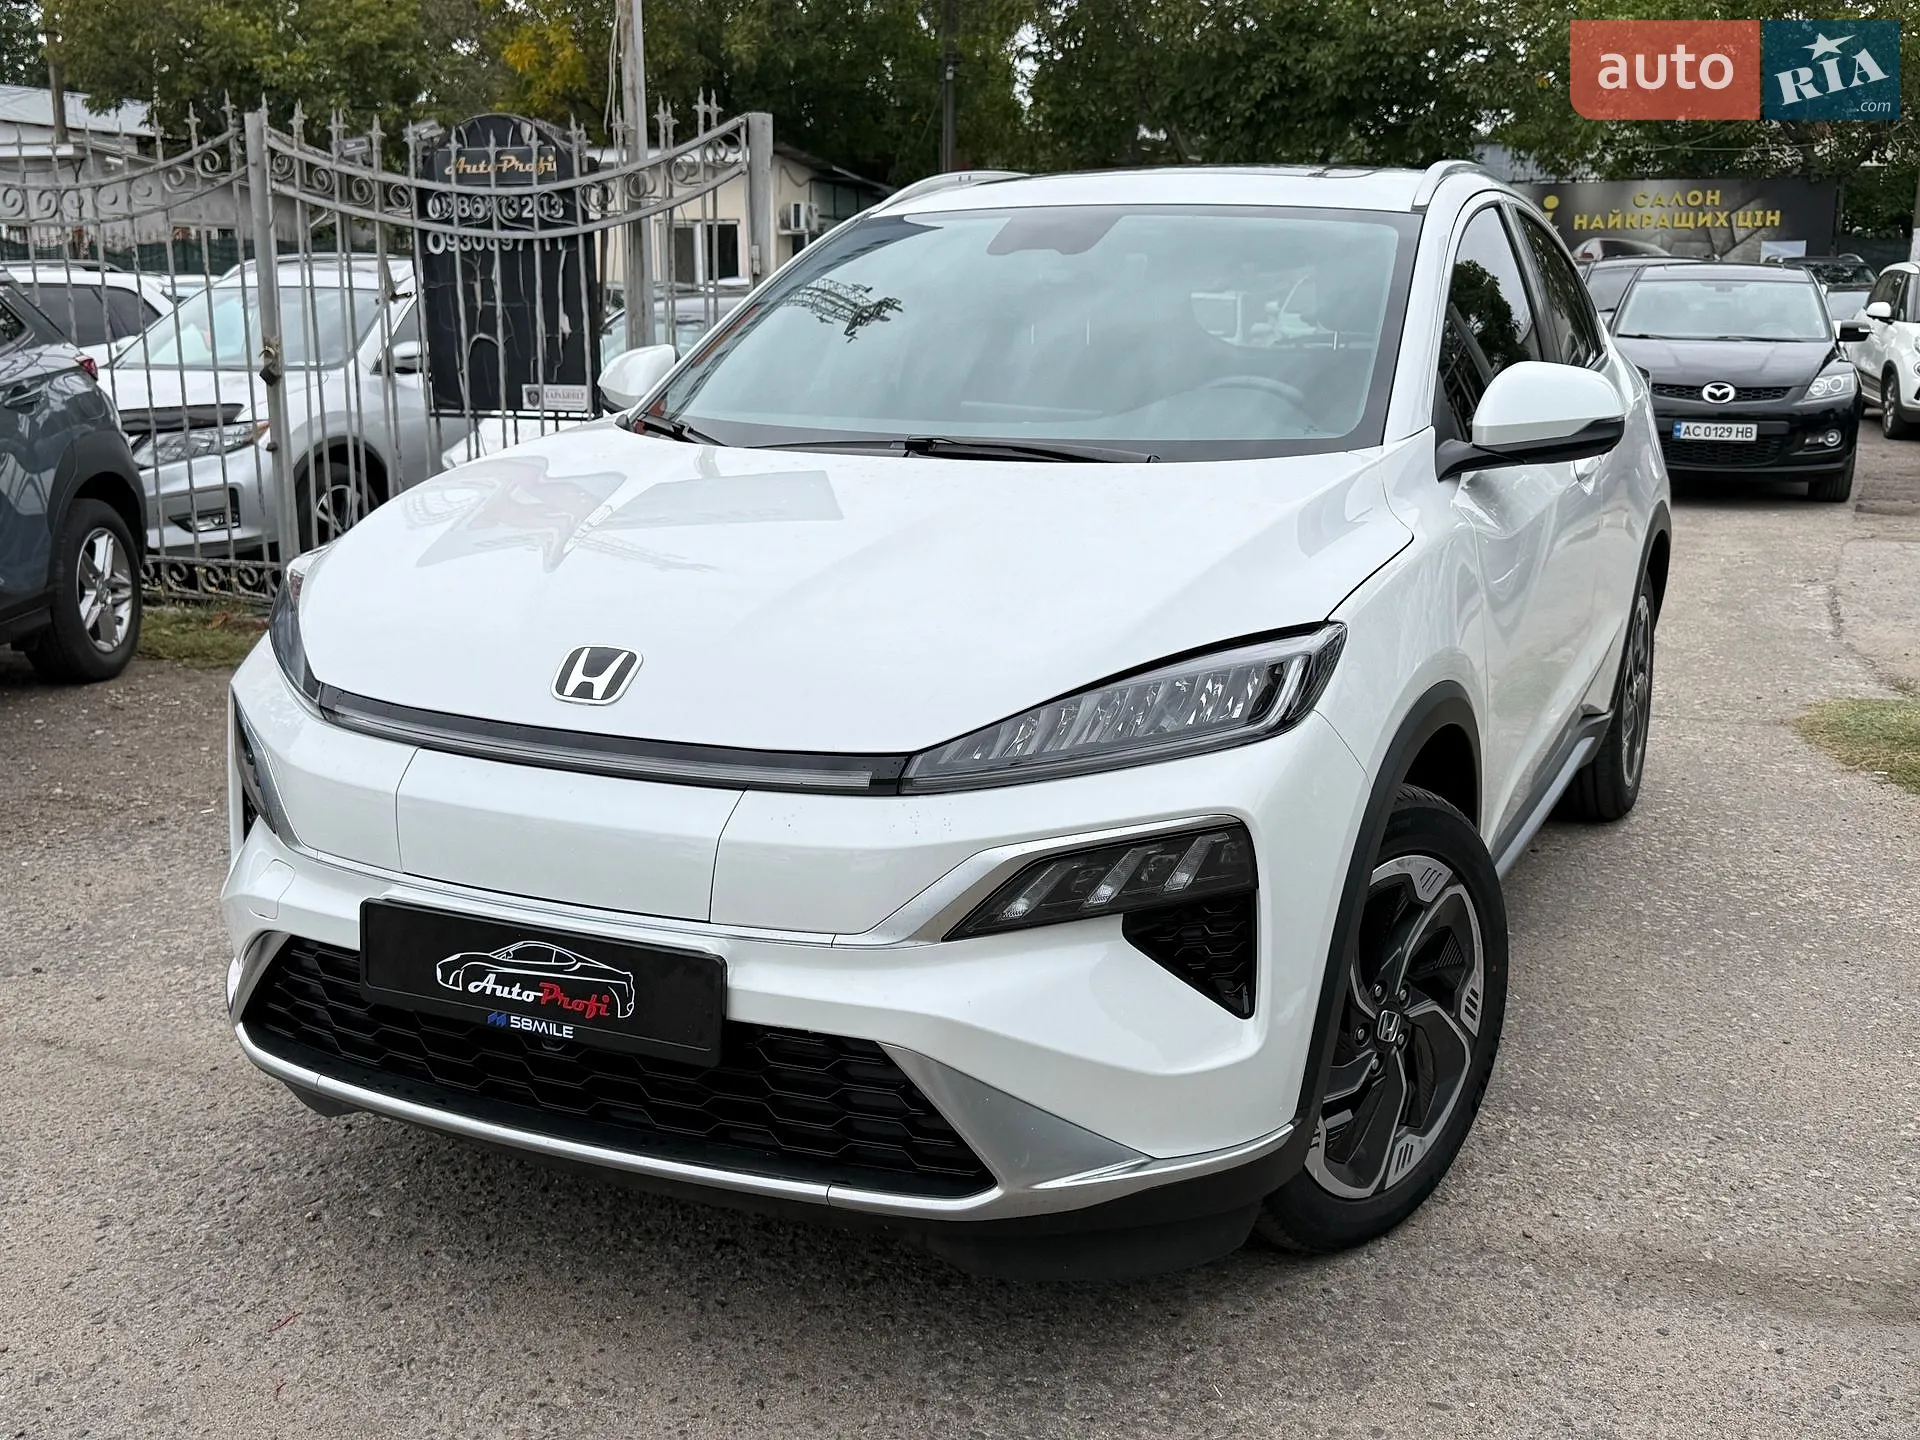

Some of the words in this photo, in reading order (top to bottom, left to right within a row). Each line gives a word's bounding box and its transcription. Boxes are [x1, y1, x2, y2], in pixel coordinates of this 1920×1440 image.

[1633, 189, 1721, 208] САЛОН
[1573, 208, 1730, 231] НАЙКРАЩИХ
[1736, 209, 1782, 228] ЦІН
[1683, 425, 1701, 437] AC
[1704, 426, 1733, 438] 0129
[1735, 427, 1753, 439] HB
[468, 973, 611, 1019] AutoProfi
[509, 1015, 575, 1039] 58MILE
